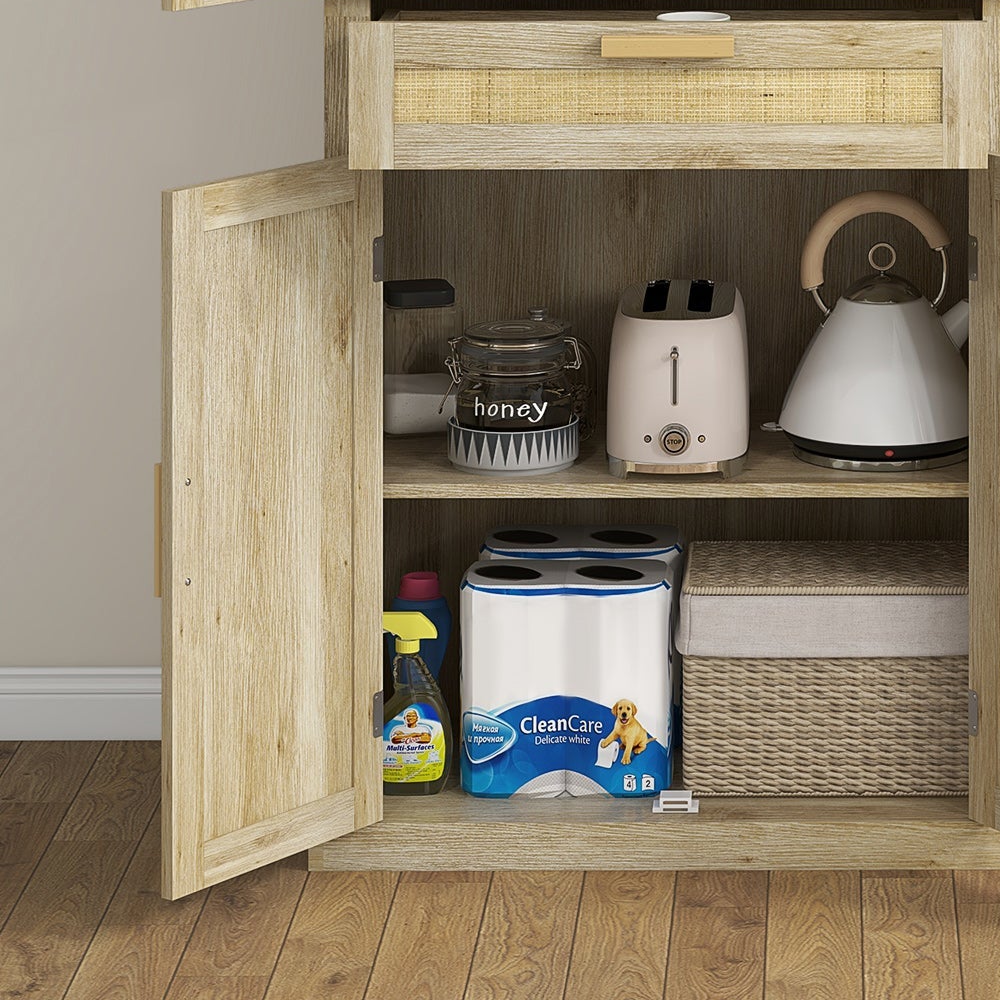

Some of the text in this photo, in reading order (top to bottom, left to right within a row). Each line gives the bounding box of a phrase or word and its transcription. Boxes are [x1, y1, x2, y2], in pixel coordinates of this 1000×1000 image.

[474, 396, 548, 423] honey
[472, 722, 499, 734] Мягкая
[520, 715, 603, 735] CleanCare
[473, 735, 504, 746] прочная
[534, 735, 591, 746] Delicate white
[626, 780, 632, 788] 4
[645, 779, 651, 788] 2
